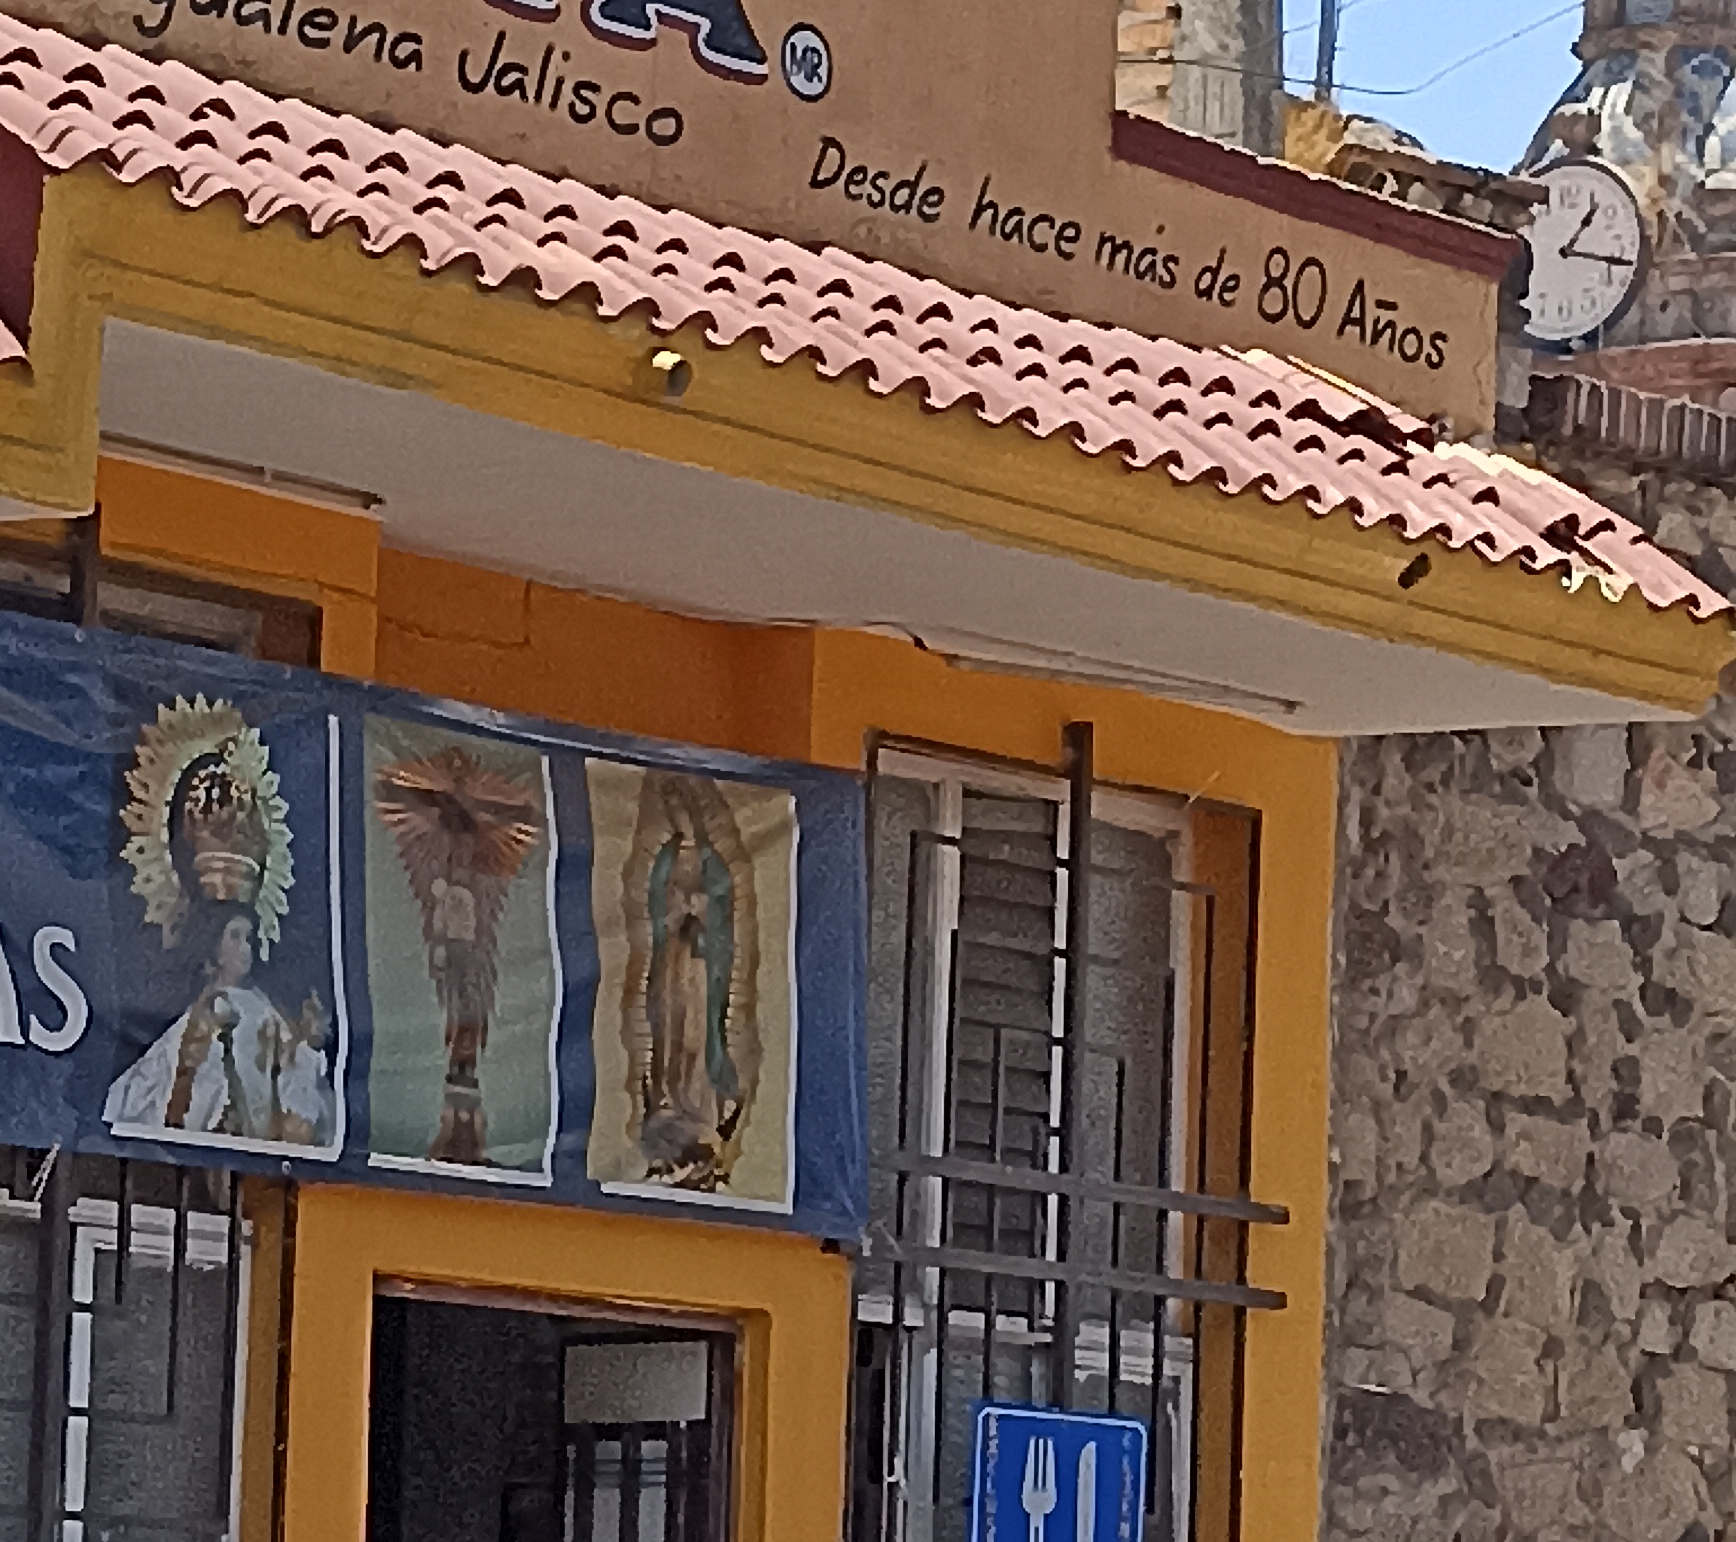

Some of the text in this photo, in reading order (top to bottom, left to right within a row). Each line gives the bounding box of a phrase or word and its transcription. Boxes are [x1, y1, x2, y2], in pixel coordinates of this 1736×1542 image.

[455, 30, 684, 147] Jalisco
[809, 135, 1449, 370] Desde hace más de 80 Años
